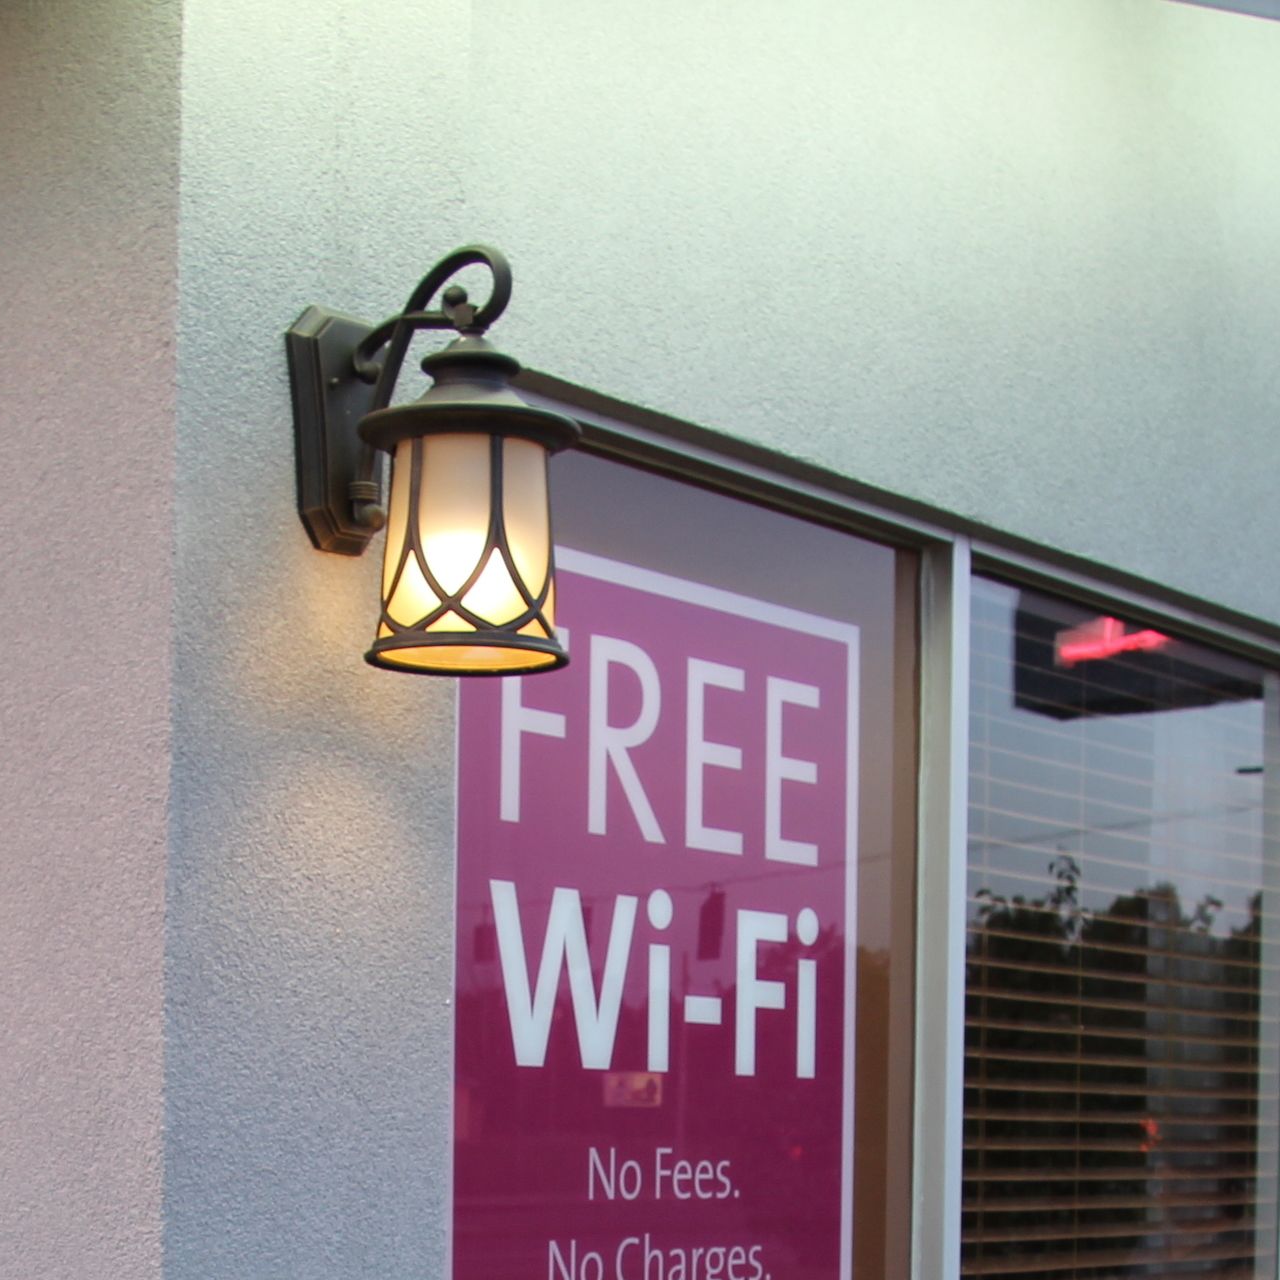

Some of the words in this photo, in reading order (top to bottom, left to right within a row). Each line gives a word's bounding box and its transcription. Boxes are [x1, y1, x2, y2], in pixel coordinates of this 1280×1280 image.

[499, 627, 820, 867] FREE
[489, 879, 819, 1079] Wi-Fi
[588, 1147, 642, 1200] No
[655, 1147, 740, 1200] Fees.
